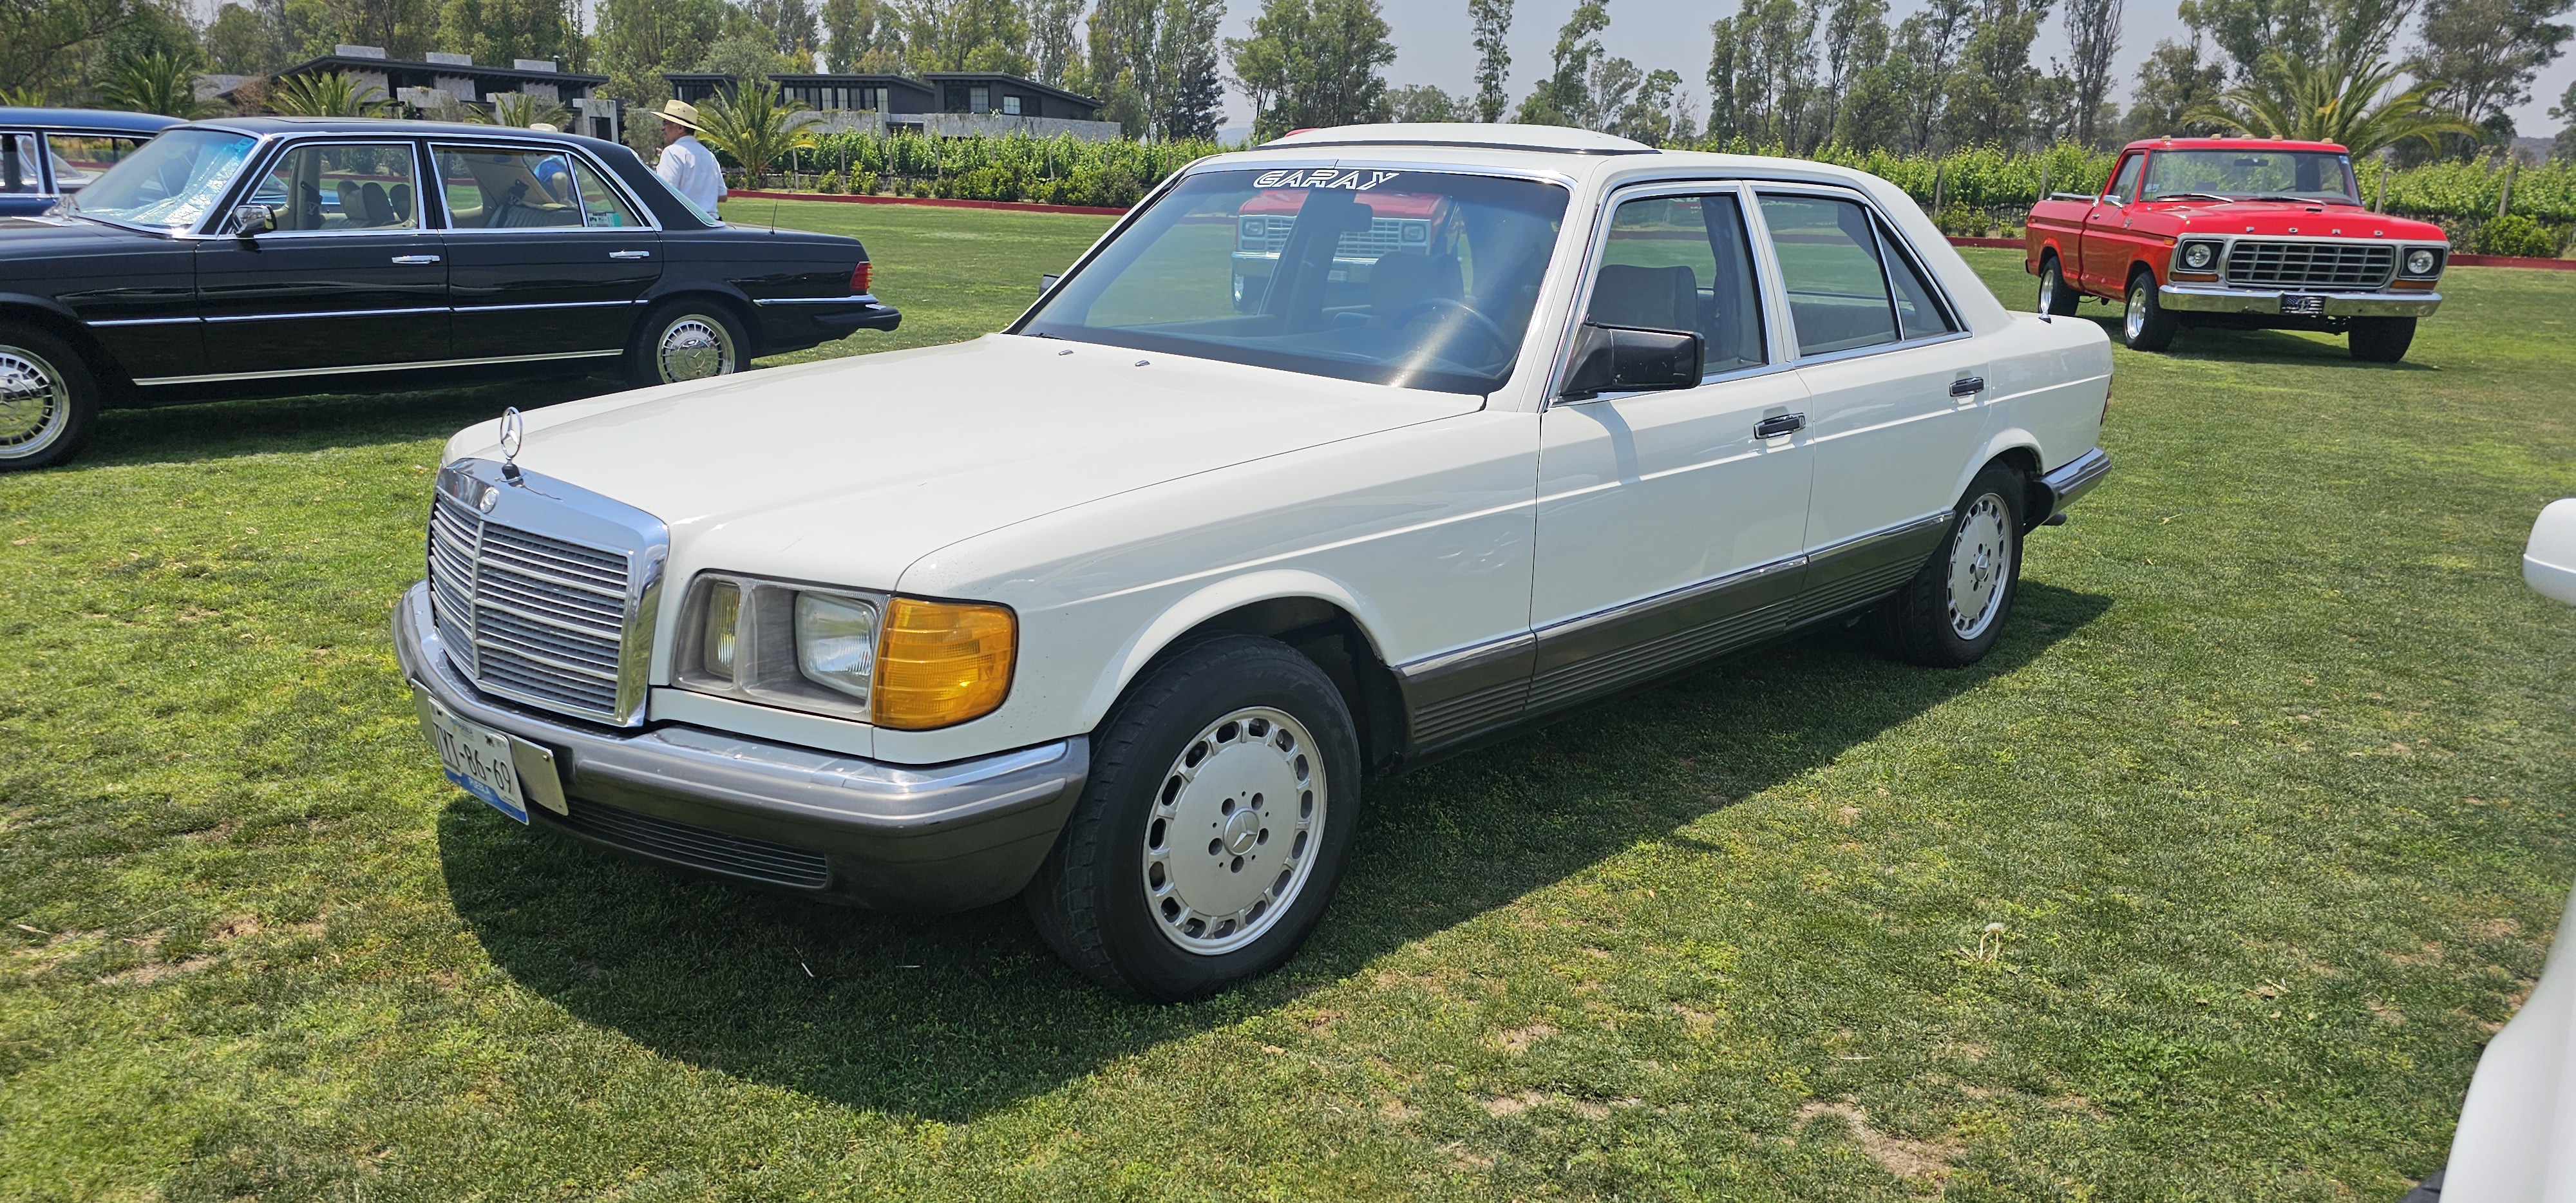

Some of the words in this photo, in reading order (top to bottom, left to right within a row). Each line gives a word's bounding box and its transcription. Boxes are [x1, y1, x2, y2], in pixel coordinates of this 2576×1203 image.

[1253, 169, 1401, 191] GARAY
[2246, 226, 2384, 236] FORD
[433, 721, 511, 794] TYT-86-69
